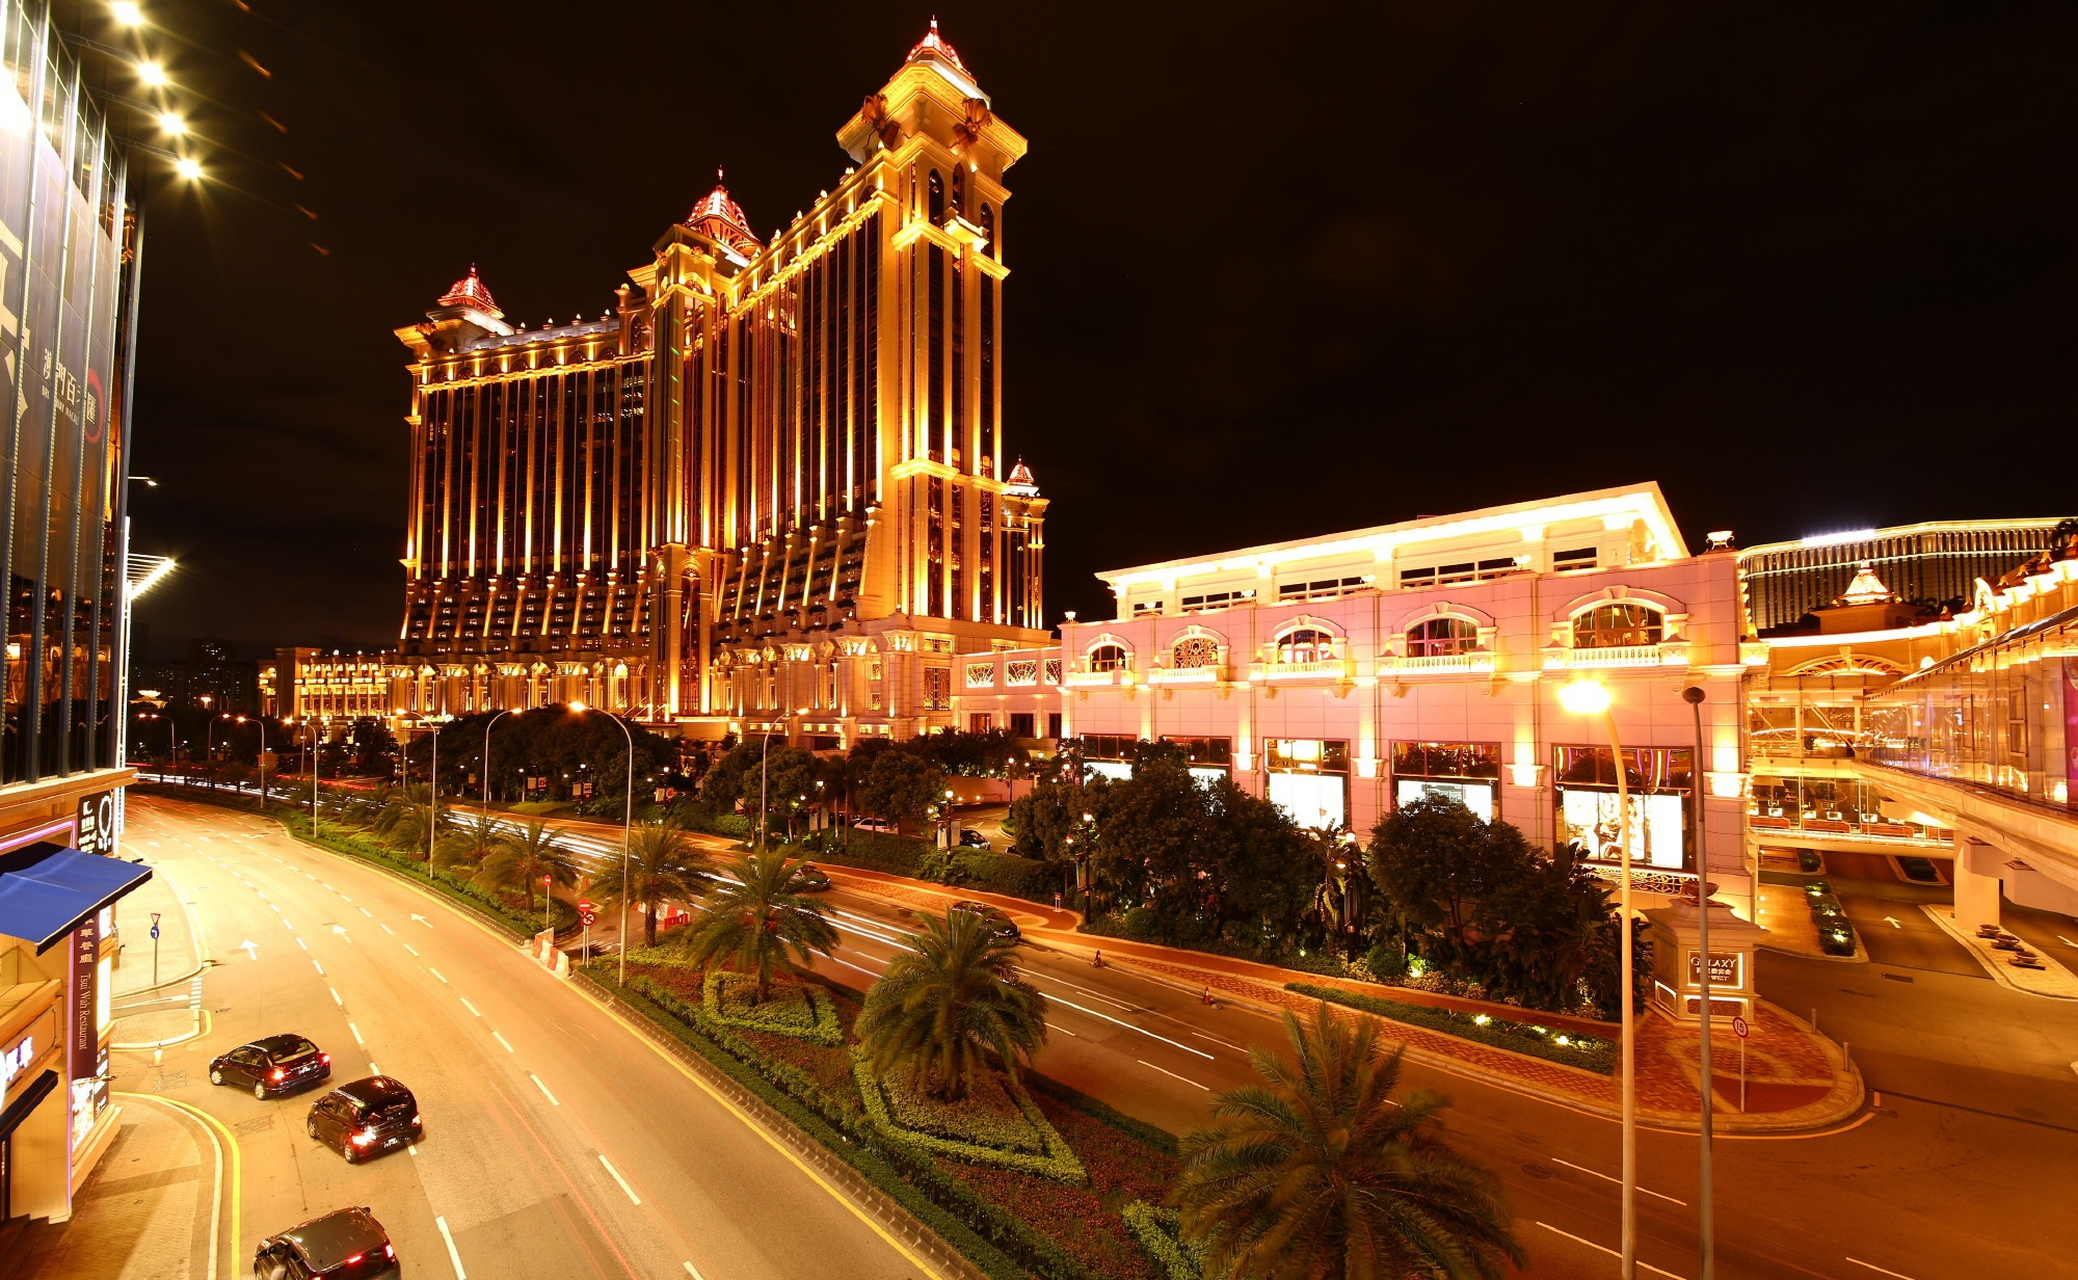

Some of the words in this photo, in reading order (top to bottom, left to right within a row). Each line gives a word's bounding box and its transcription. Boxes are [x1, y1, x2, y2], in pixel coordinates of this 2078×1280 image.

[43, 347, 97, 425] 澳門百匯
[1690, 956, 1737, 968] GLAXY
[80, 972, 91, 990] Tsui
[80, 991, 91, 1010] Wah
[79, 1010, 90, 1050] Restaurant
[1736, 1022, 1744, 1034] 15
